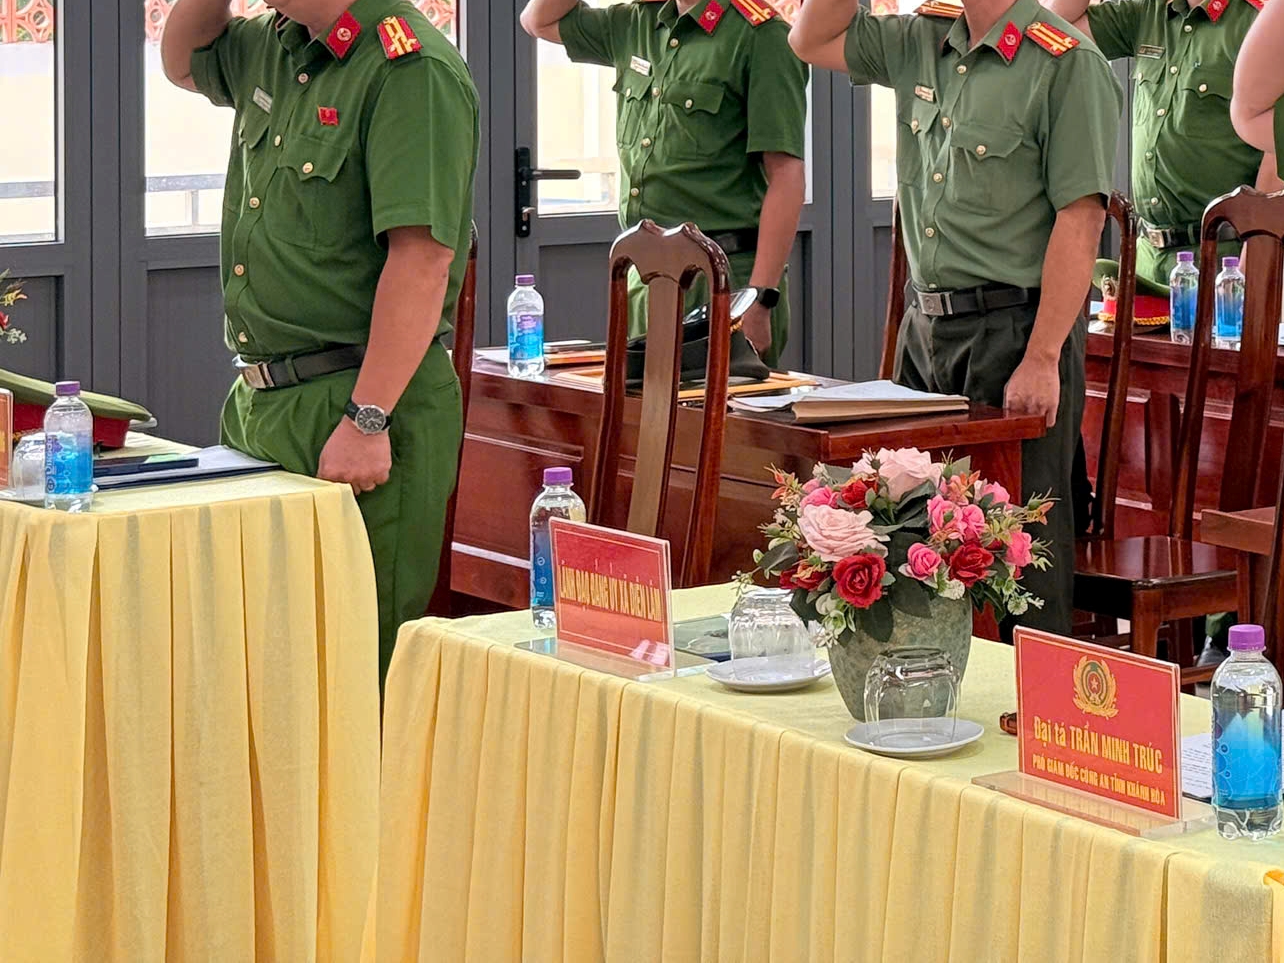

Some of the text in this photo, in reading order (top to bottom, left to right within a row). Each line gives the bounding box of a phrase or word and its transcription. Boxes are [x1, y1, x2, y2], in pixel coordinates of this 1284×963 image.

[1034, 716, 1051, 747] Đại
[1054, 721, 1066, 747] tá
[1101, 734, 1130, 765] MINH
[1133, 742, 1163, 774] TRÚC
